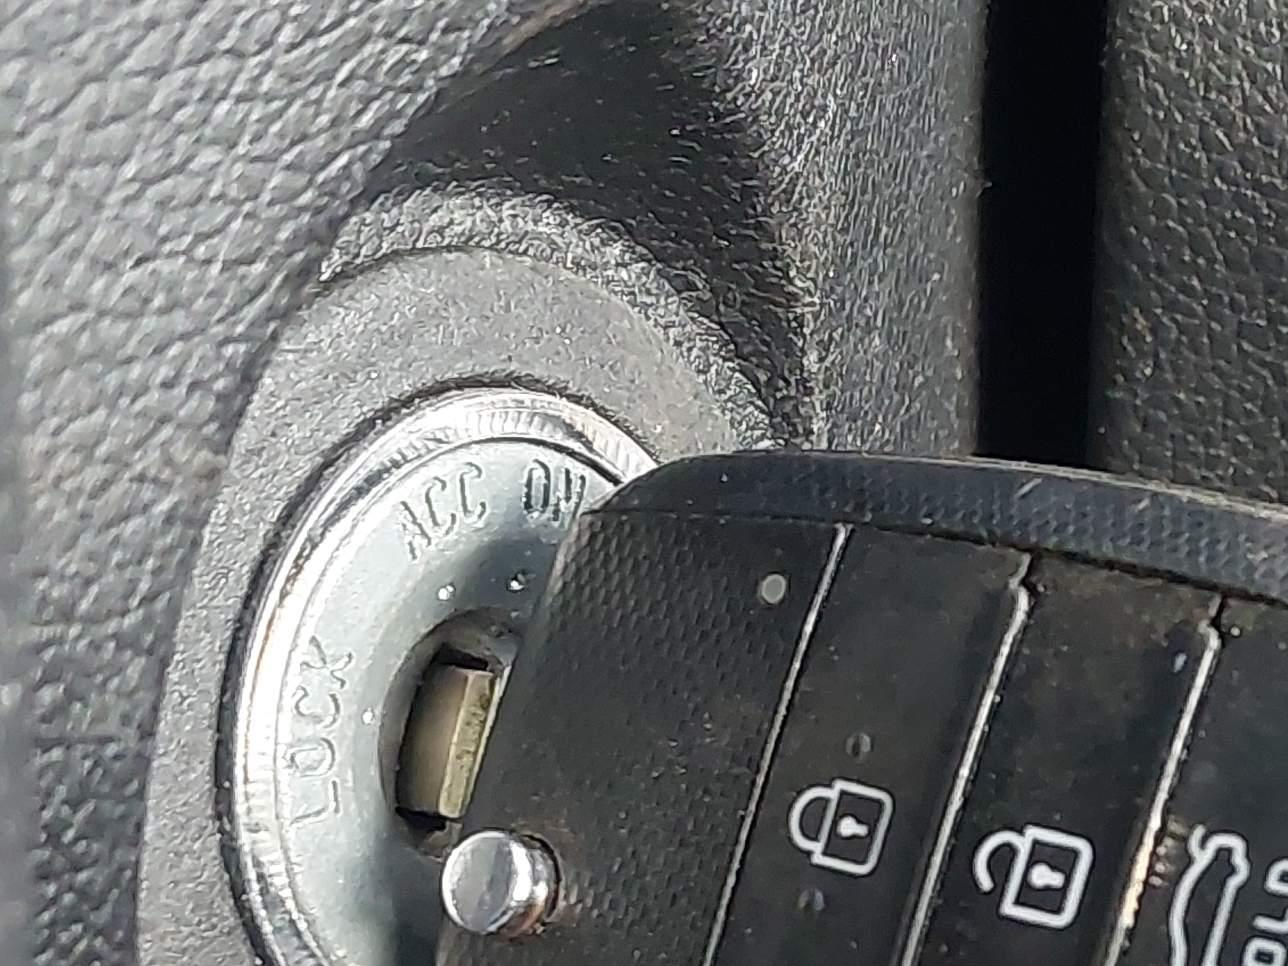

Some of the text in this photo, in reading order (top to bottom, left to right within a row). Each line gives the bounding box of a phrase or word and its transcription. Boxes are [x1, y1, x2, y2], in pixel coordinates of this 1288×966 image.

[400, 458, 586, 560] ACC ON
[287, 635, 354, 828] LOCK
